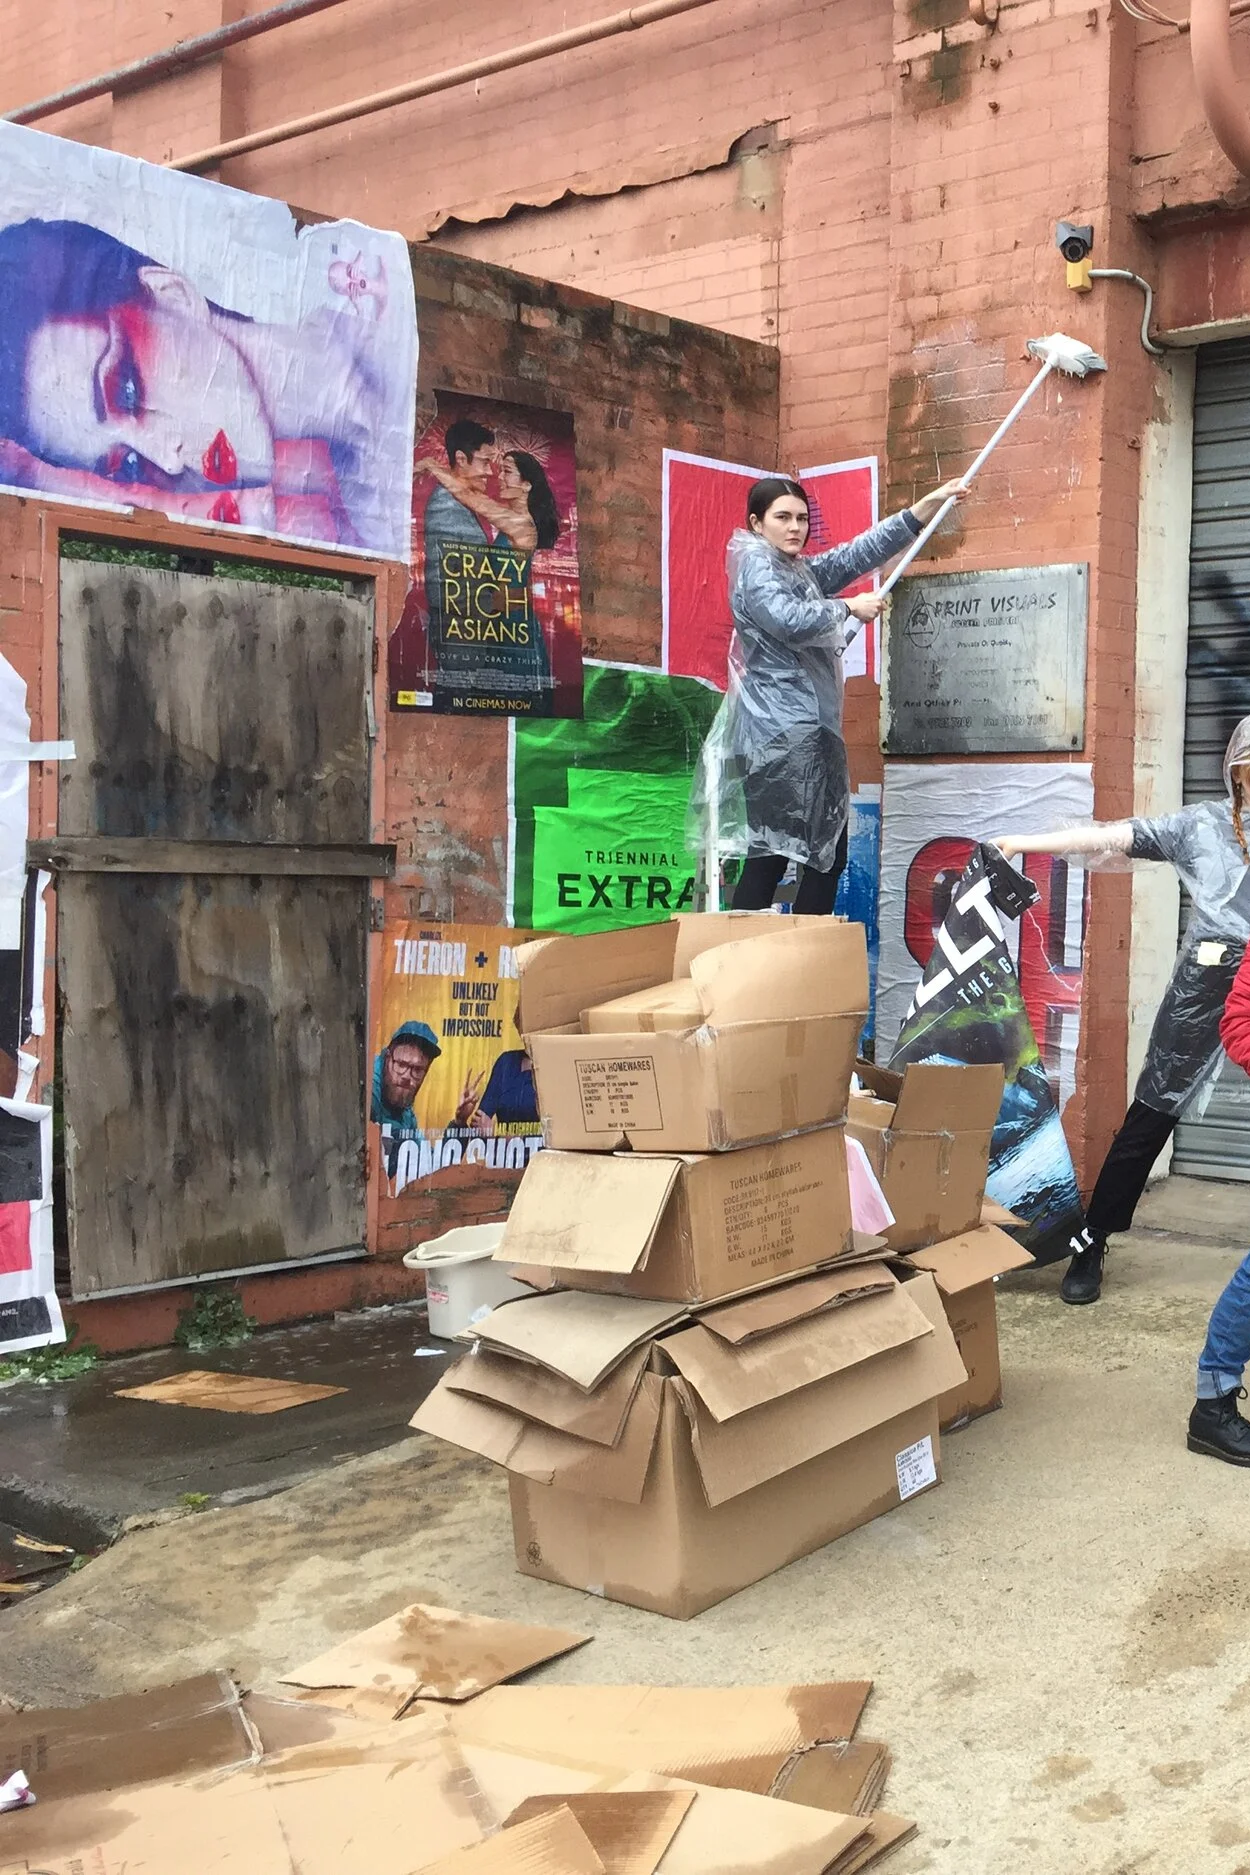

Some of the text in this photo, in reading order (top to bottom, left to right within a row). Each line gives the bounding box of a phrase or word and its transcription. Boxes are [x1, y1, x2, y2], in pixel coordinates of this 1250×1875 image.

[443, 552, 527, 583] CRAZY
[445, 579, 528, 620] RICH
[934, 592, 1058, 618] PRINT VISUALS
[446, 618, 529, 646] ASIANS
[485, 656, 513, 664] CRAZY
[452, 698, 532, 710] IN CINEMAS NOW
[585, 850, 679, 867] TRIENNIAL
[394, 939, 467, 977] THERON
[452, 982, 499, 1001] UNLIKELY
[957, 971, 994, 1005] THE
[459, 1002, 490, 1017] BUT NOT
[442, 1018, 503, 1038] IMPOSSIBLE
[579, 1060, 651, 1074] TUSCAN HOMEWARES
[730, 1162, 803, 1190] TUSCAN HOMEWARES
[751, 1247, 794, 1268] MADE IN CHINA
